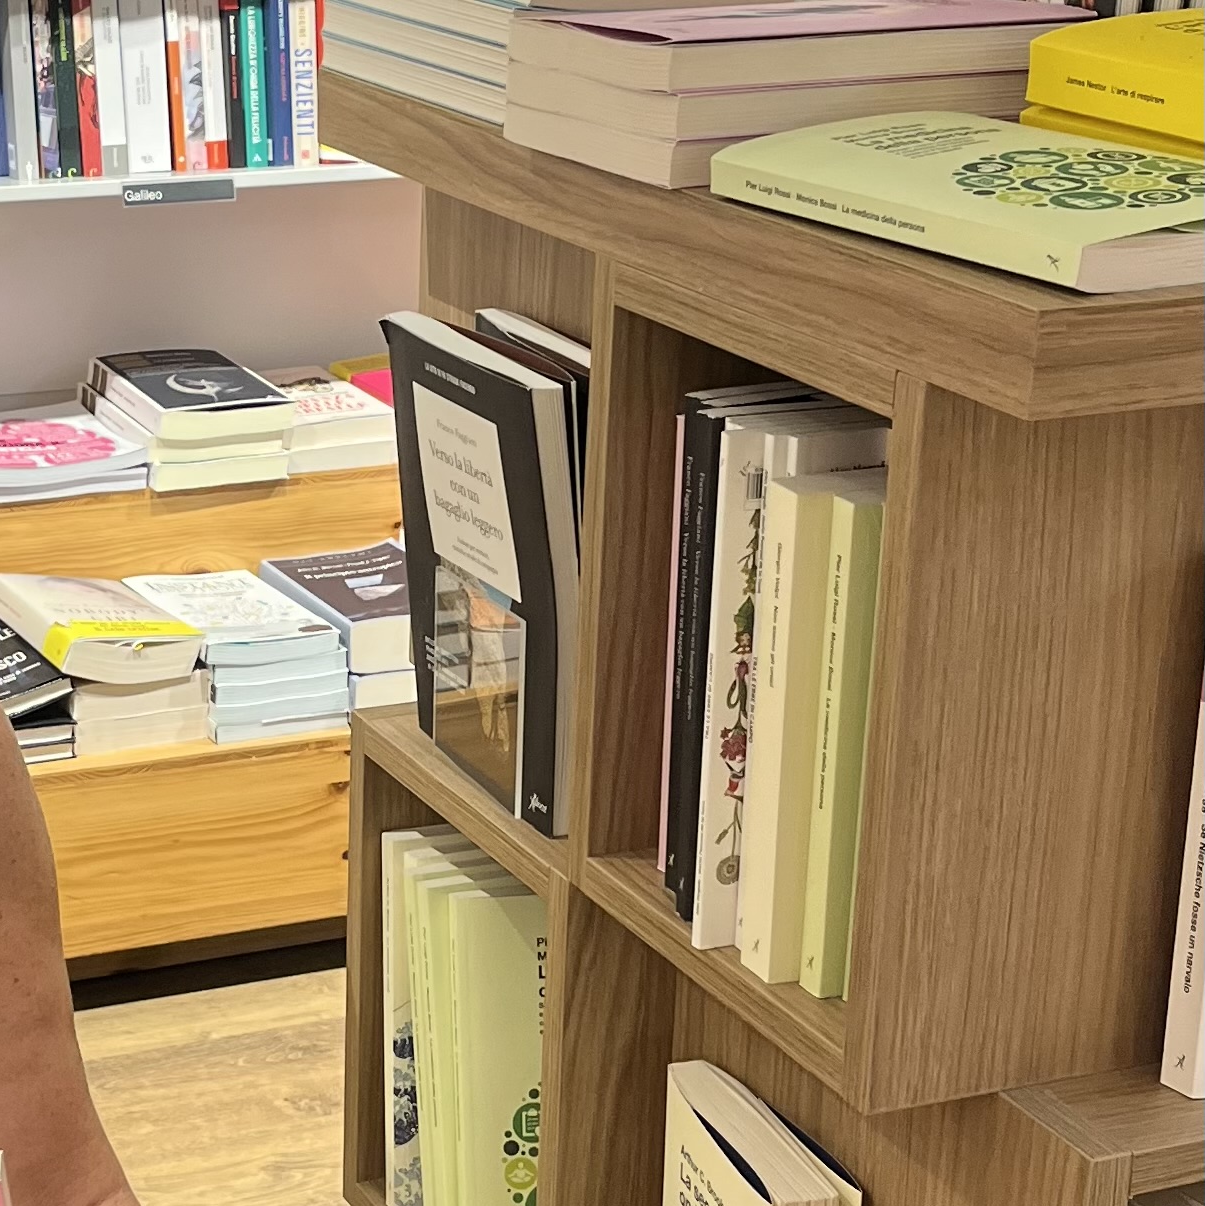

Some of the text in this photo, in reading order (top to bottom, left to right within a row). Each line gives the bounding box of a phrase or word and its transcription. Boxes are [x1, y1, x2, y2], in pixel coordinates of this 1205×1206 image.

[245, 15, 258, 59] LUNGHEZZA
[248, 59, 259, 89] D'ONDA
[249, 90, 259, 111] DELLA
[293, 47, 316, 136] SENZIENTI
[1065, 75, 1085, 87] James
[1109, 85, 1129, 97] L'arte
[1135, 91, 1165, 106] respirare
[250, 112, 262, 144] FELICITÀ
[124, 189, 164, 202] Galileo
[744, 179, 757, 189] Pier
[756, 183, 774, 195] Luigi
[772, 186, 791, 198] Rossi
[840, 204, 850, 213] La
[850, 206, 880, 221] medicina
[880, 214, 897, 226] della
[896, 219, 926, 234] persona
[428, 438, 494, 488] Verso la libertà
[450, 479, 480, 505] con un
[471, 510, 504, 542] leggero
[1183, 841, 1205, 994] Nietzsche fosse un narvalo
[680, 1162, 692, 1192] La
